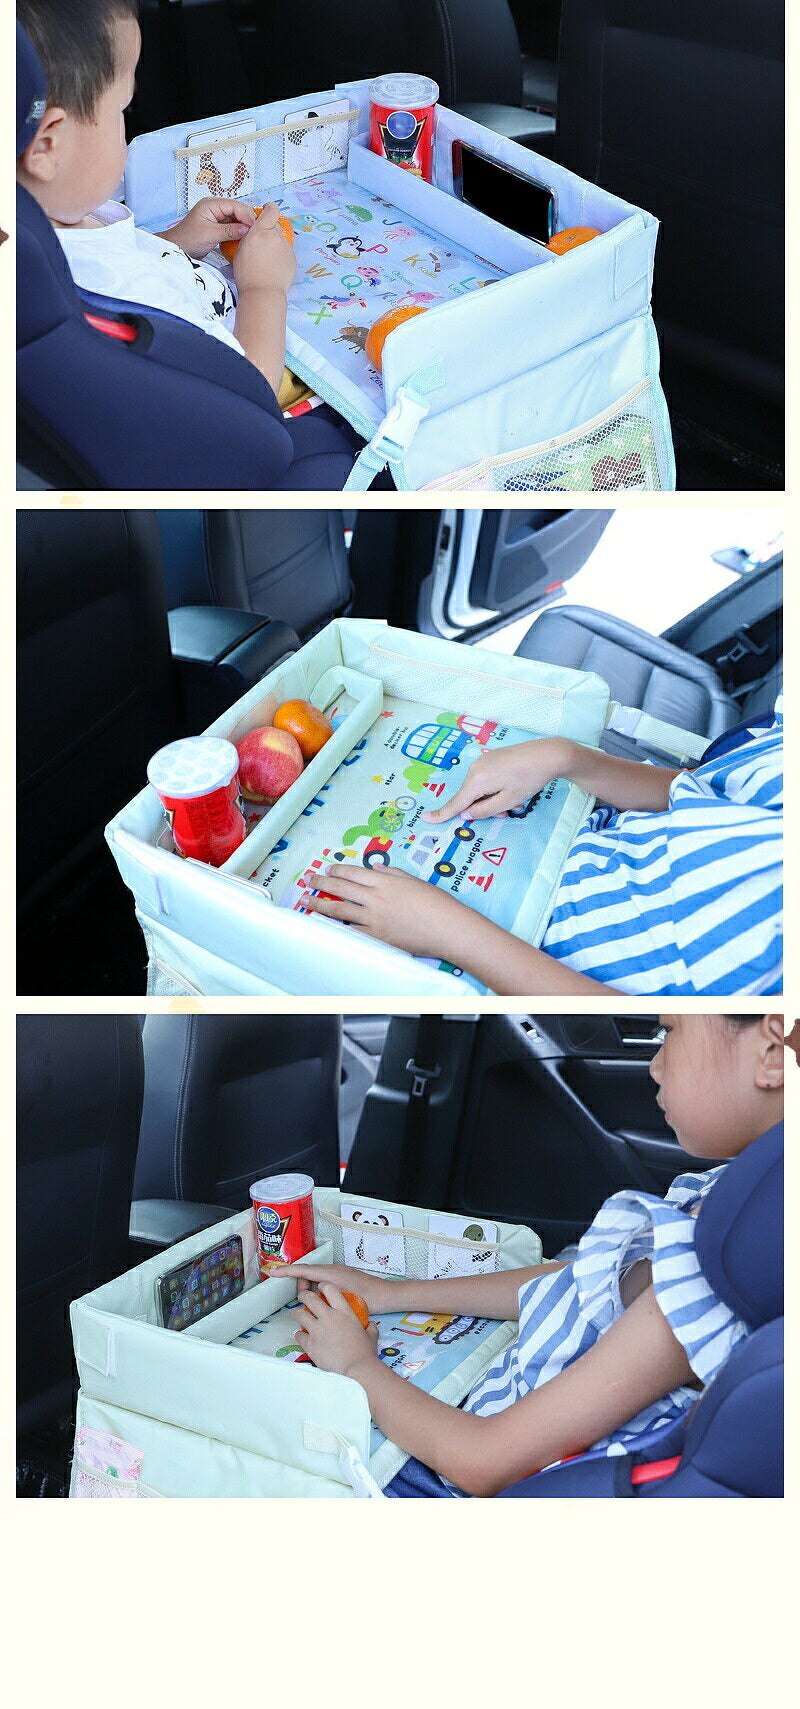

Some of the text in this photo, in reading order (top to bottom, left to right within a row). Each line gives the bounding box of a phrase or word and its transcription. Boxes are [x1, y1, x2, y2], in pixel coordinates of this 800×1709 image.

[261, 867, 281, 888] cket
[450, 836, 485, 893] police wagon
